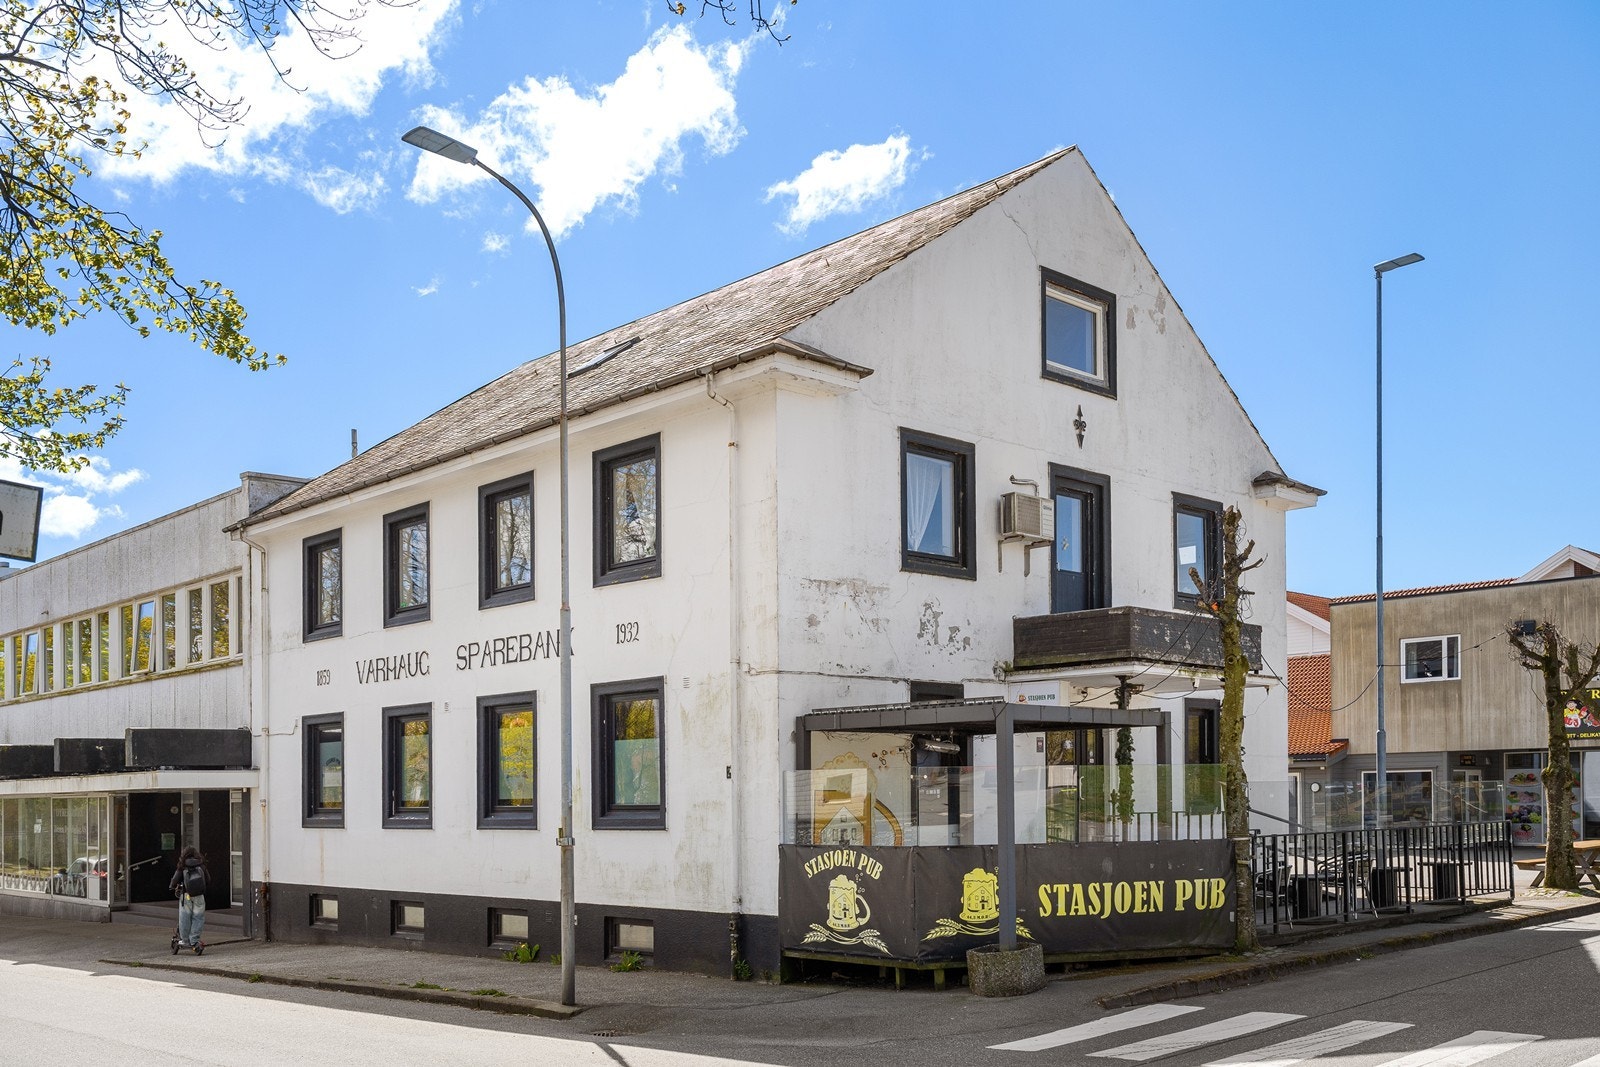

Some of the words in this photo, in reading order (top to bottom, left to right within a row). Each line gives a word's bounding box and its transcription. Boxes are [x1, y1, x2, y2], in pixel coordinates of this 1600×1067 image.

[615, 621, 640, 645] 1932
[804, 849, 857, 879] STASJOEN
[857, 853, 883, 880] PUB
[1038, 880, 1165, 919] STASJOEN
[1174, 877, 1226, 911] PUB
